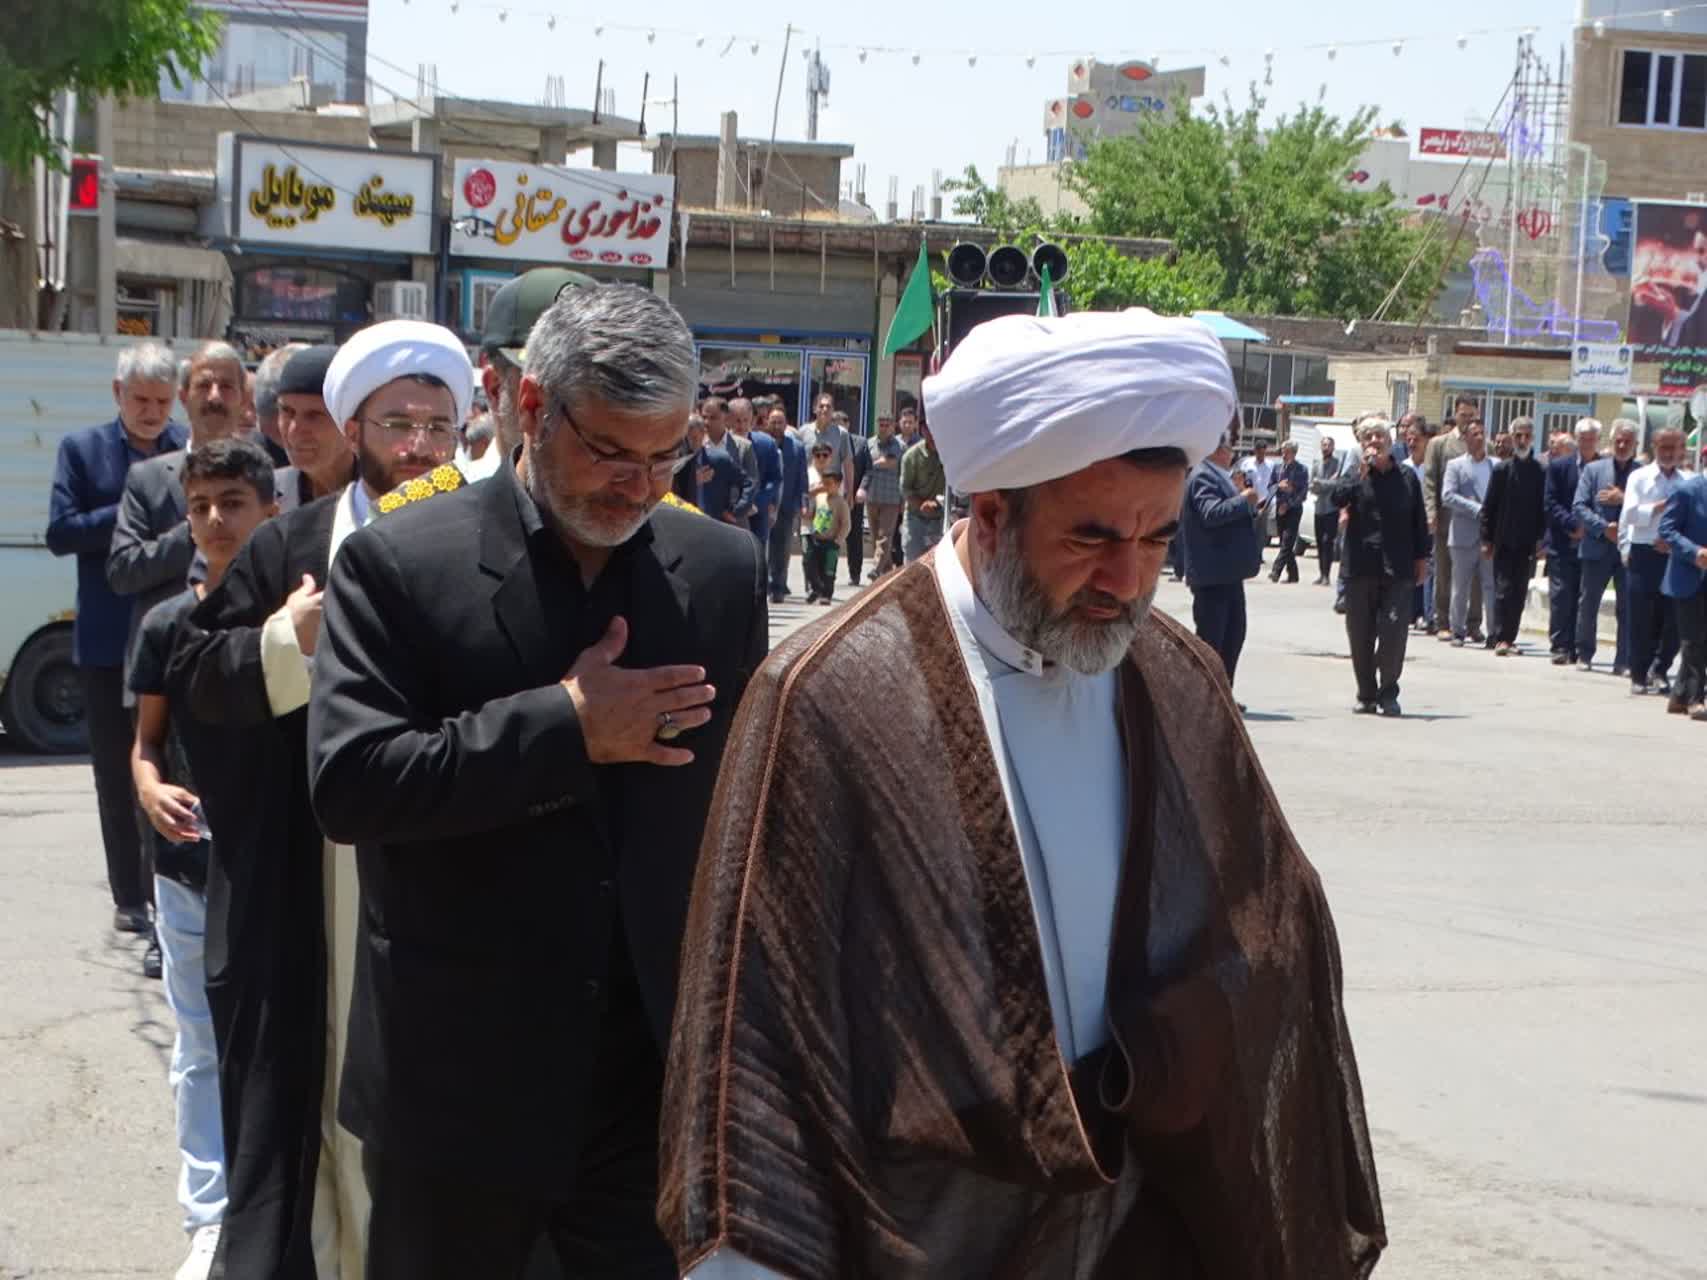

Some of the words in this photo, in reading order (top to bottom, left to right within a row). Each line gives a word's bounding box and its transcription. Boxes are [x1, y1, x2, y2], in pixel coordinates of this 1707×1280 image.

[249, 165, 334, 228] موبایل
[354, 174, 415, 226] سهند
[495, 173, 567, 246] ممقانی
[562, 190, 663, 246] غذاخوری
[1597, 361, 1629, 377] ایستگاه
